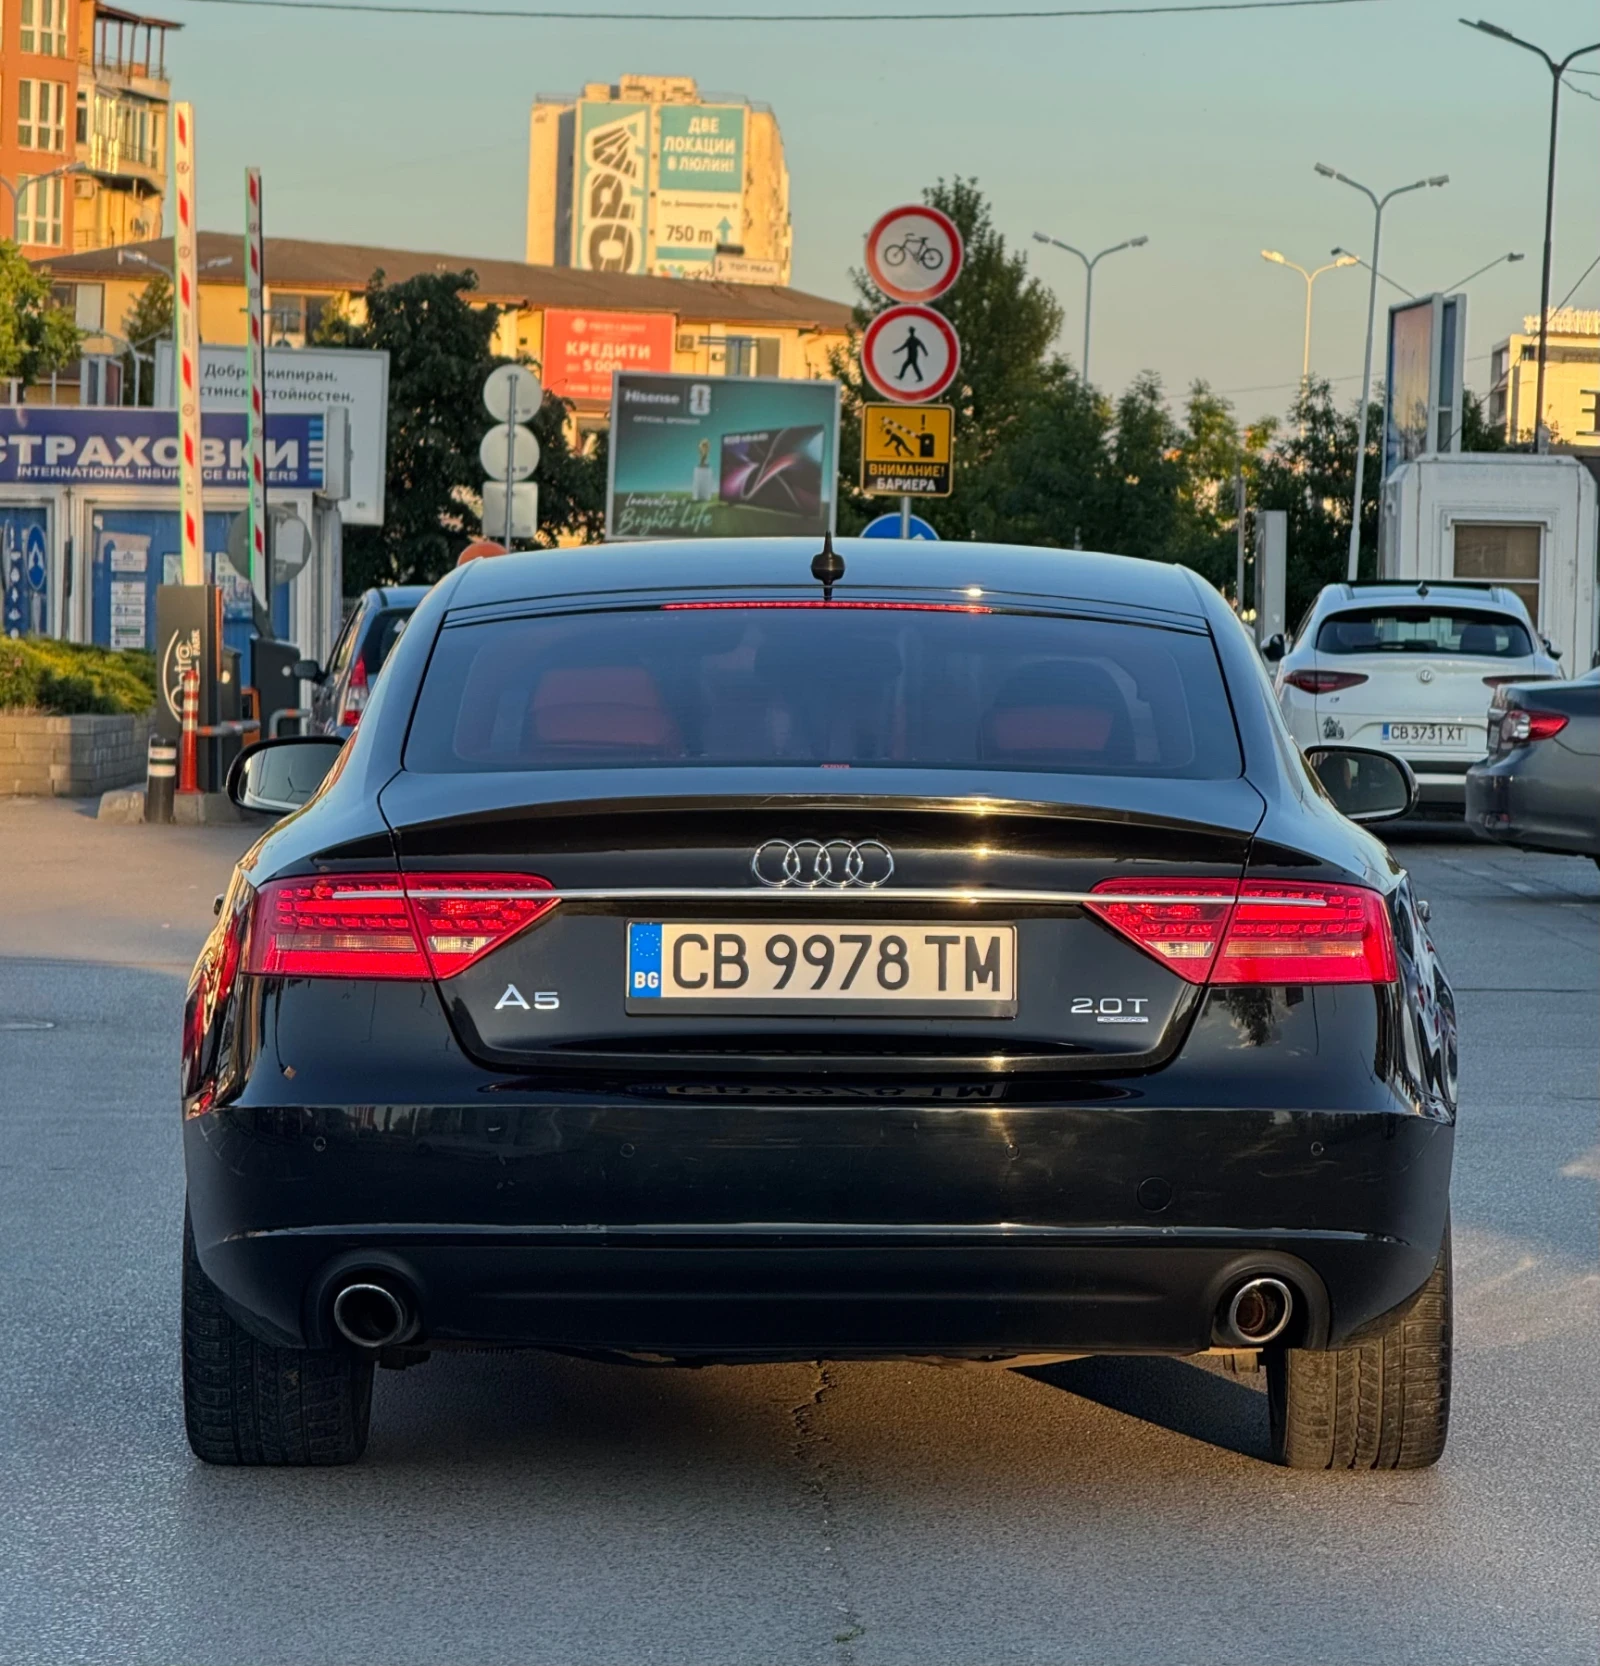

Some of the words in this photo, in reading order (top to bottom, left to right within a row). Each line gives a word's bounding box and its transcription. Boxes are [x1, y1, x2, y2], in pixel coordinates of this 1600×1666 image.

[688, 117, 719, 134] ДВЕ
[663, 136, 735, 154] ЛОКАЦИИ
[666, 225, 694, 241] 750
[699, 230, 713, 242] m
[566, 341, 651, 359] КРЕДИТИ
[205, 363, 250, 379] Добр
[266, 371, 338, 383] кипиран.
[625, 389, 680, 404] Hisense
[0, 435, 298, 468] ТРАХОВКИ
[17, 465, 134, 479] INTERNATIONAL
[138, 468, 222, 480] INSURCE
[869, 463, 945, 477] ВНИМАНИЕ!
[877, 478, 936, 491] БАРИЕРА
[617, 507, 677, 536] Brighter
[1391, 726, 1409, 740] CB
[1411, 727, 1443, 741] 3731
[1447, 727, 1464, 741] XT
[672, 933, 750, 990] CB
[765, 934, 910, 991] 9978
[924, 935, 1002, 992] TM
[634, 971, 659, 989] BG
[494, 983, 559, 1009] A5
[1071, 998, 1149, 1013] 2.0T
